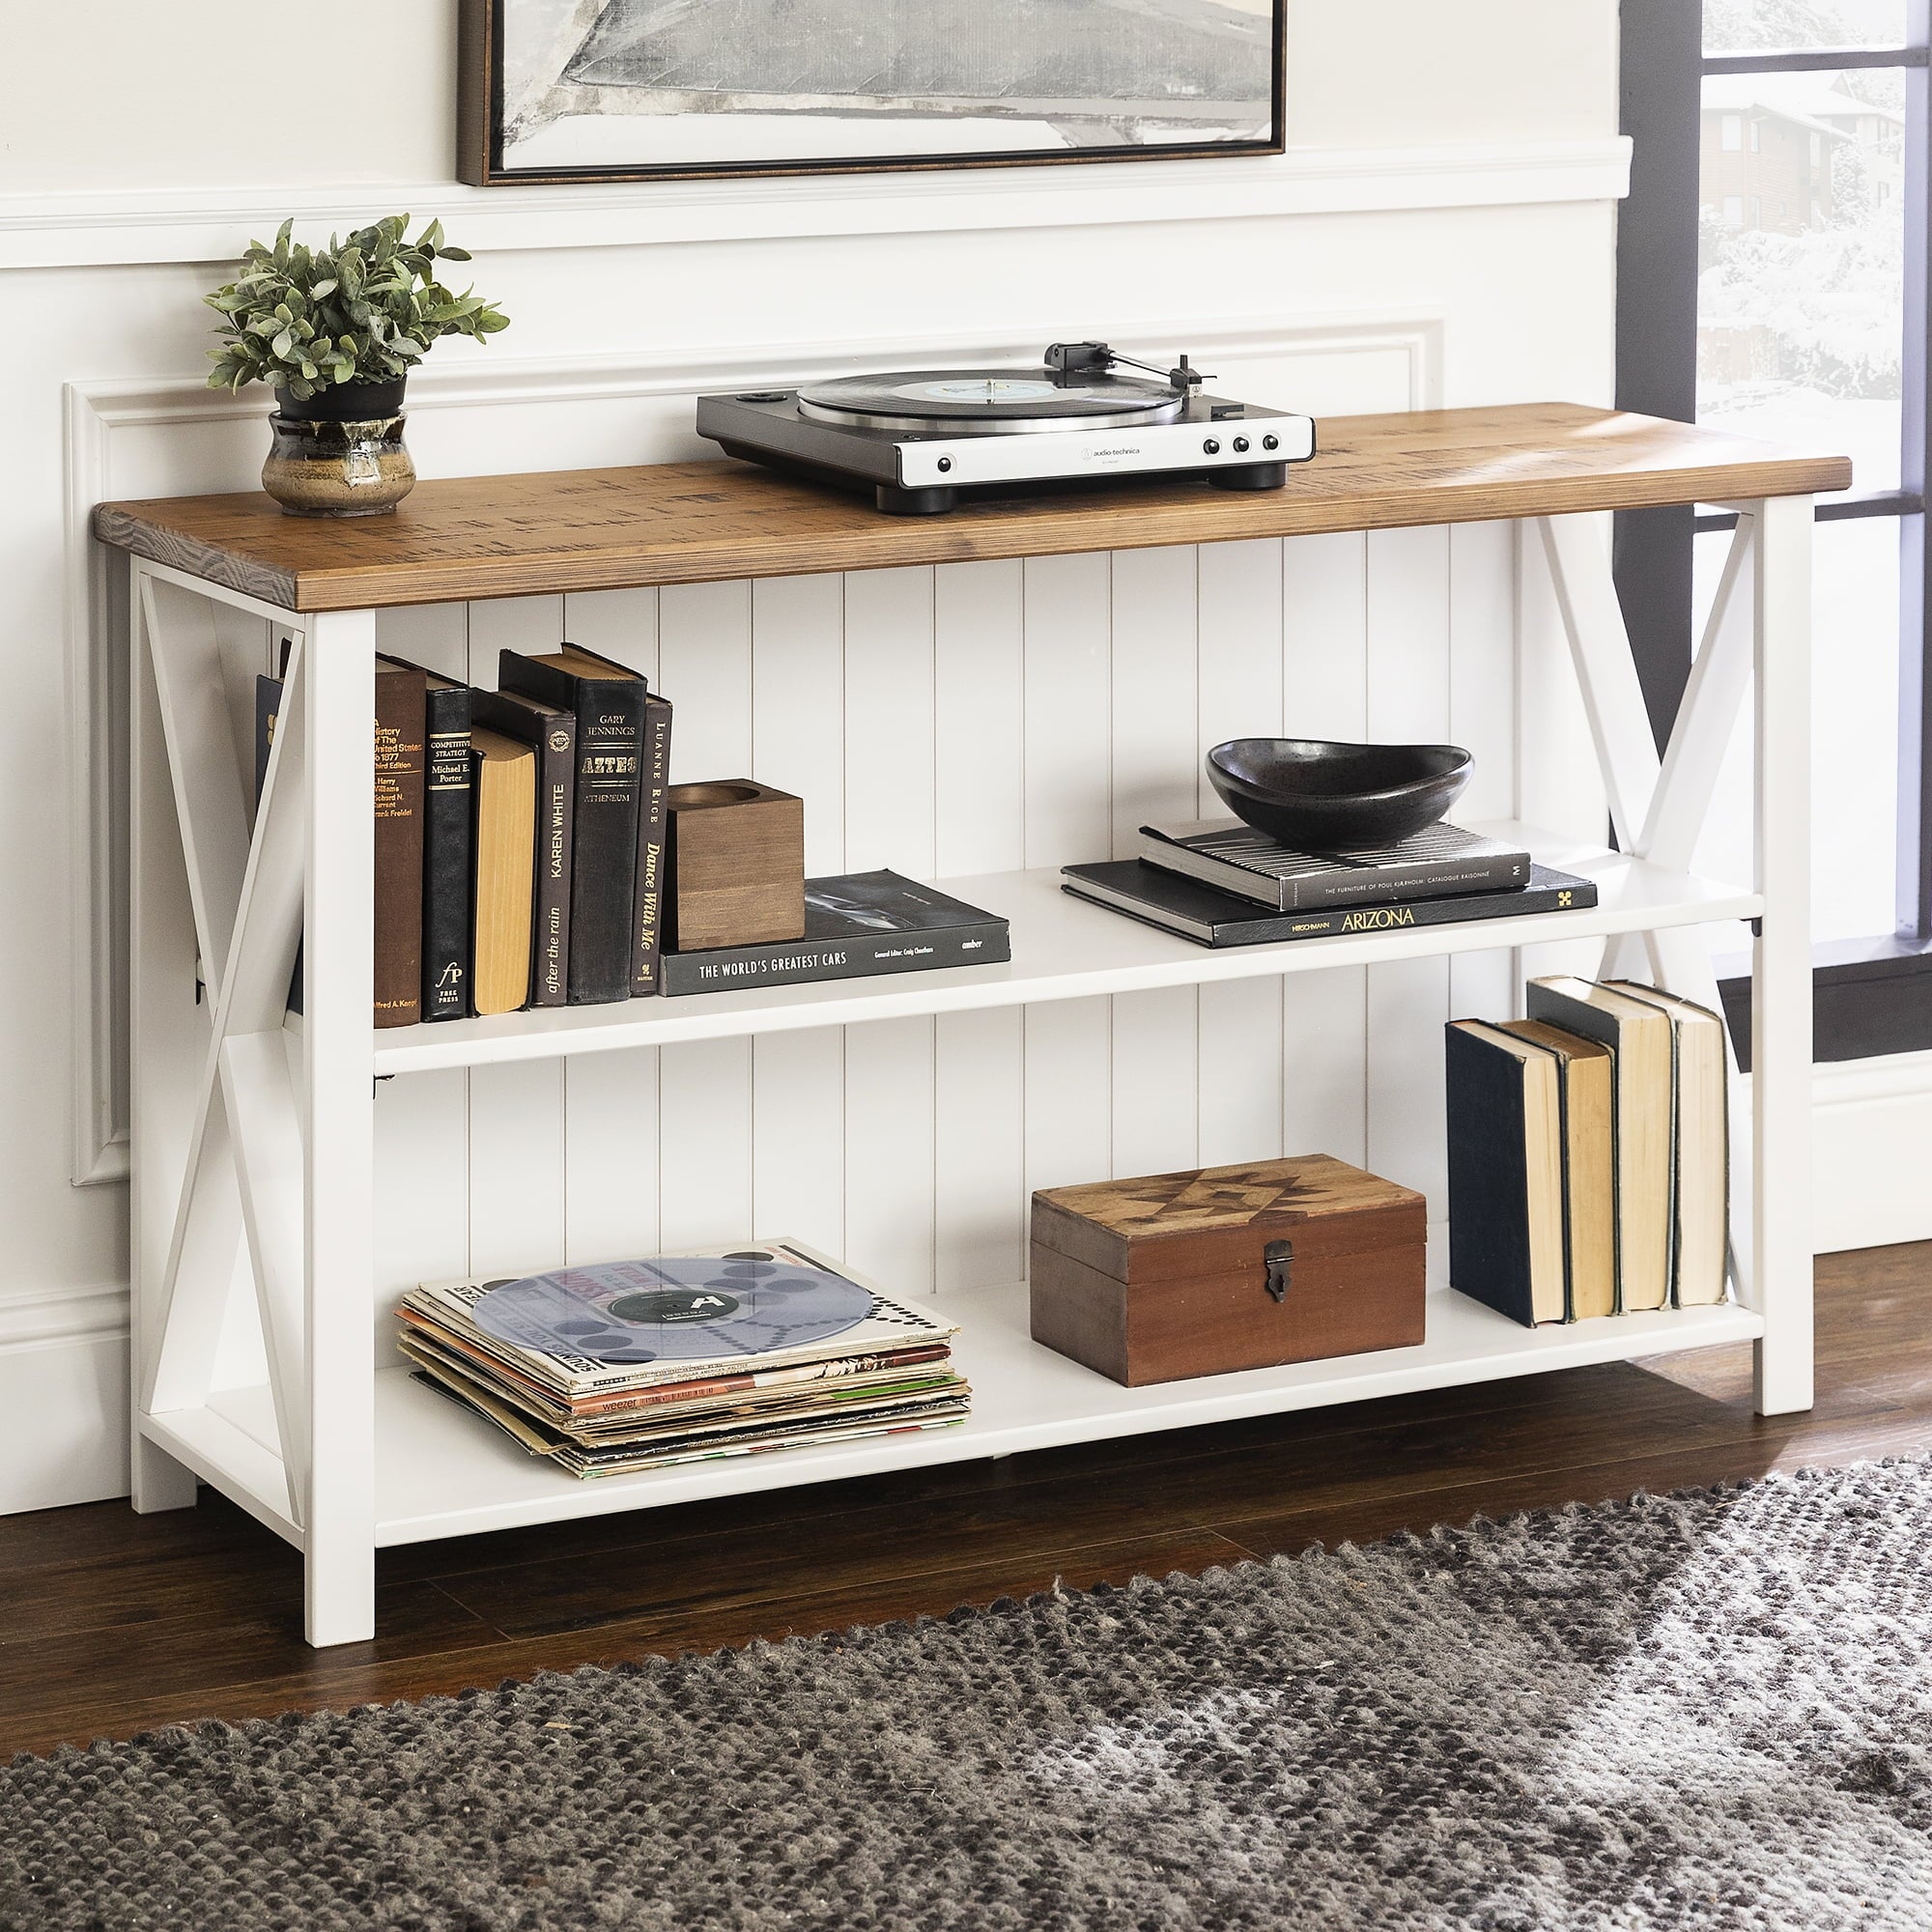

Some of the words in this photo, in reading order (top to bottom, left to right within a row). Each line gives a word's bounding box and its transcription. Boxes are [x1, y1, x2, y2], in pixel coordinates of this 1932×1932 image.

[599, 715, 626, 724] GARY
[586, 726, 636, 737] JENNINGS
[436, 749, 468, 757] STRATEGY
[653, 723, 667, 780] LUANNE
[432, 764, 461, 774] Michael
[462, 764, 470, 773] E.
[582, 756, 638, 774] AZTEC
[440, 775, 463, 783] Porter
[375, 793, 396, 802] ichard
[552, 783, 564, 828] WHITE
[583, 794, 630, 803] ATHENEUM
[650, 788, 662, 823] RICE
[551, 830, 563, 878] KAREN
[644, 842, 661, 889] Dance
[1337, 885, 1367, 894] FURNITURE
[1427, 875, 1460, 884] CATALOGUE
[642, 893, 658, 925] With
[548, 907, 560, 934] rain
[1292, 922, 1330, 932] HIRSCHMANN
[1341, 908, 1415, 932] ARIZONA
[547, 937, 559, 958] the
[640, 927, 655, 951] Me
[961, 939, 983, 950] amber
[699, 965, 719, 979] THE
[722, 959, 768, 977] WORLD'S
[771, 954, 818, 972] GREATEST
[822, 952, 847, 966] CARS
[546, 961, 560, 994] after
[602, 1399, 638, 1411] weezer
